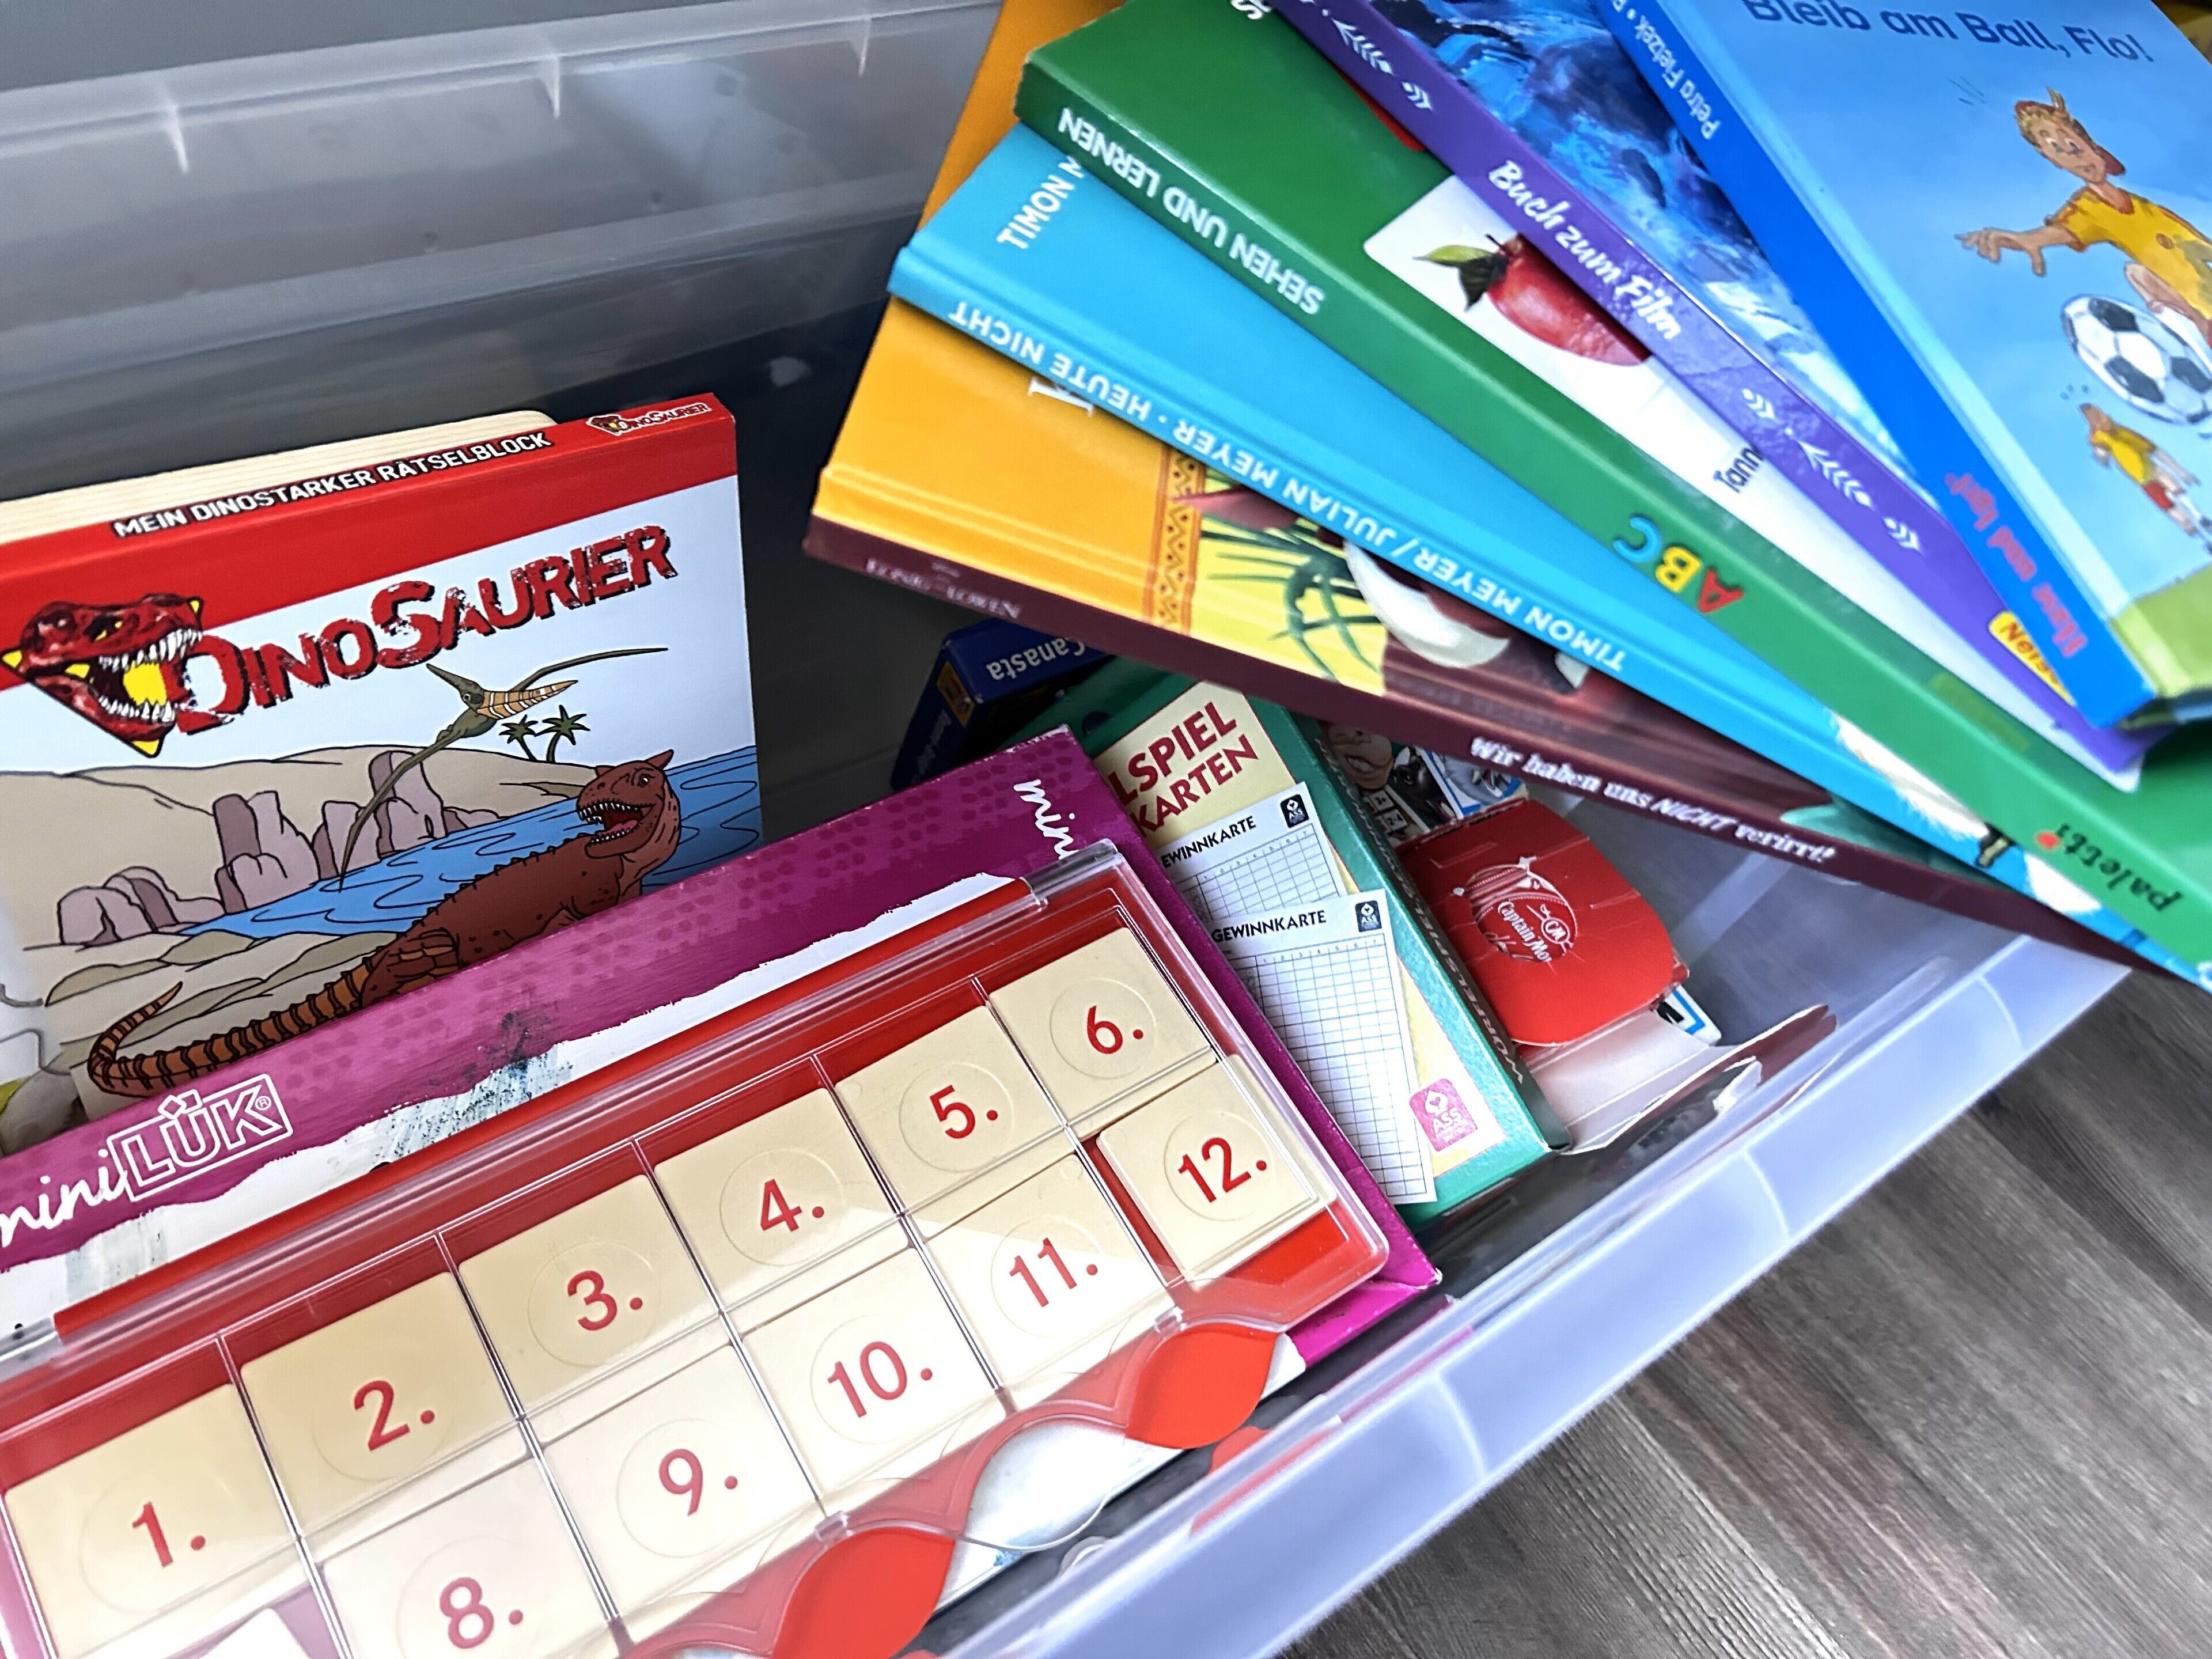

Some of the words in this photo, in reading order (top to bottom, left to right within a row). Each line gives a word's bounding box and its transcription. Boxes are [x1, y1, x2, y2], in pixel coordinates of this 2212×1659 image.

[1743, 0, 1871, 30] Bleib
[1880, 10, 1959, 39] am
[1955, 12, 2071, 58] Ball,
[2062, 25, 2154, 62] Flo!
[1680, 79, 1720, 139] Petra
[1058, 108, 1161, 198] LERNEN
[996, 174, 1075, 249] TIMON
[1162, 187, 1228, 248] UND
[1229, 233, 1325, 315] SEHEN
[1488, 160, 1571, 230] Buch
[1555, 225, 1623, 285] zum
[1614, 275, 1682, 340] Film
[948, 301, 1046, 365] NICHT
[1048, 352, 1152, 422] HEUTE
[114, 509, 187, 538] MEIN
[190, 469, 377, 522] DINOSTARKER
[380, 432, 552, 482] RÄTSELBLOCK
[1172, 419, 1280, 489] MEYER
[1282, 478, 1397, 547] JULIAN
[1413, 548, 1522, 615] MEYER
[1612, 514, 1744, 615] ABC
[986, 638, 1085, 680] Canasta
[1524, 606, 1626, 672] TIMON
[1129, 733, 1259, 836] KARTEN
[1471, 737, 1524, 767] Wir
[1522, 753, 1602, 793] haben
[1603, 782, 1653, 809] uns
[1650, 797, 1738, 832] NICHT
[1733, 822, 1837, 863] verirrt!
[1013, 779, 1081, 860] min
[2036, 824, 2183, 912] paletti
[1210, 910, 1326, 943] GEWINNKARTE
[1497, 900, 1536, 942] Captain
[1086, 1005, 1144, 1055] 6.
[929, 1084, 999, 1140] 5.
[1432, 1107, 1463, 1135] ASS
[1178, 1137, 1267, 1203] 12.
[759, 1179, 824, 1232] 4.
[566, 1270, 643, 1331] 3.
[1009, 1238, 1098, 1307] 11.
[827, 1341, 933, 1419] 10.
[353, 1380, 435, 1451] 2.
[658, 1448, 738, 1516] 9.
[132, 1502, 206, 1567] 1.
[440, 1577, 523, 1649] 8.
